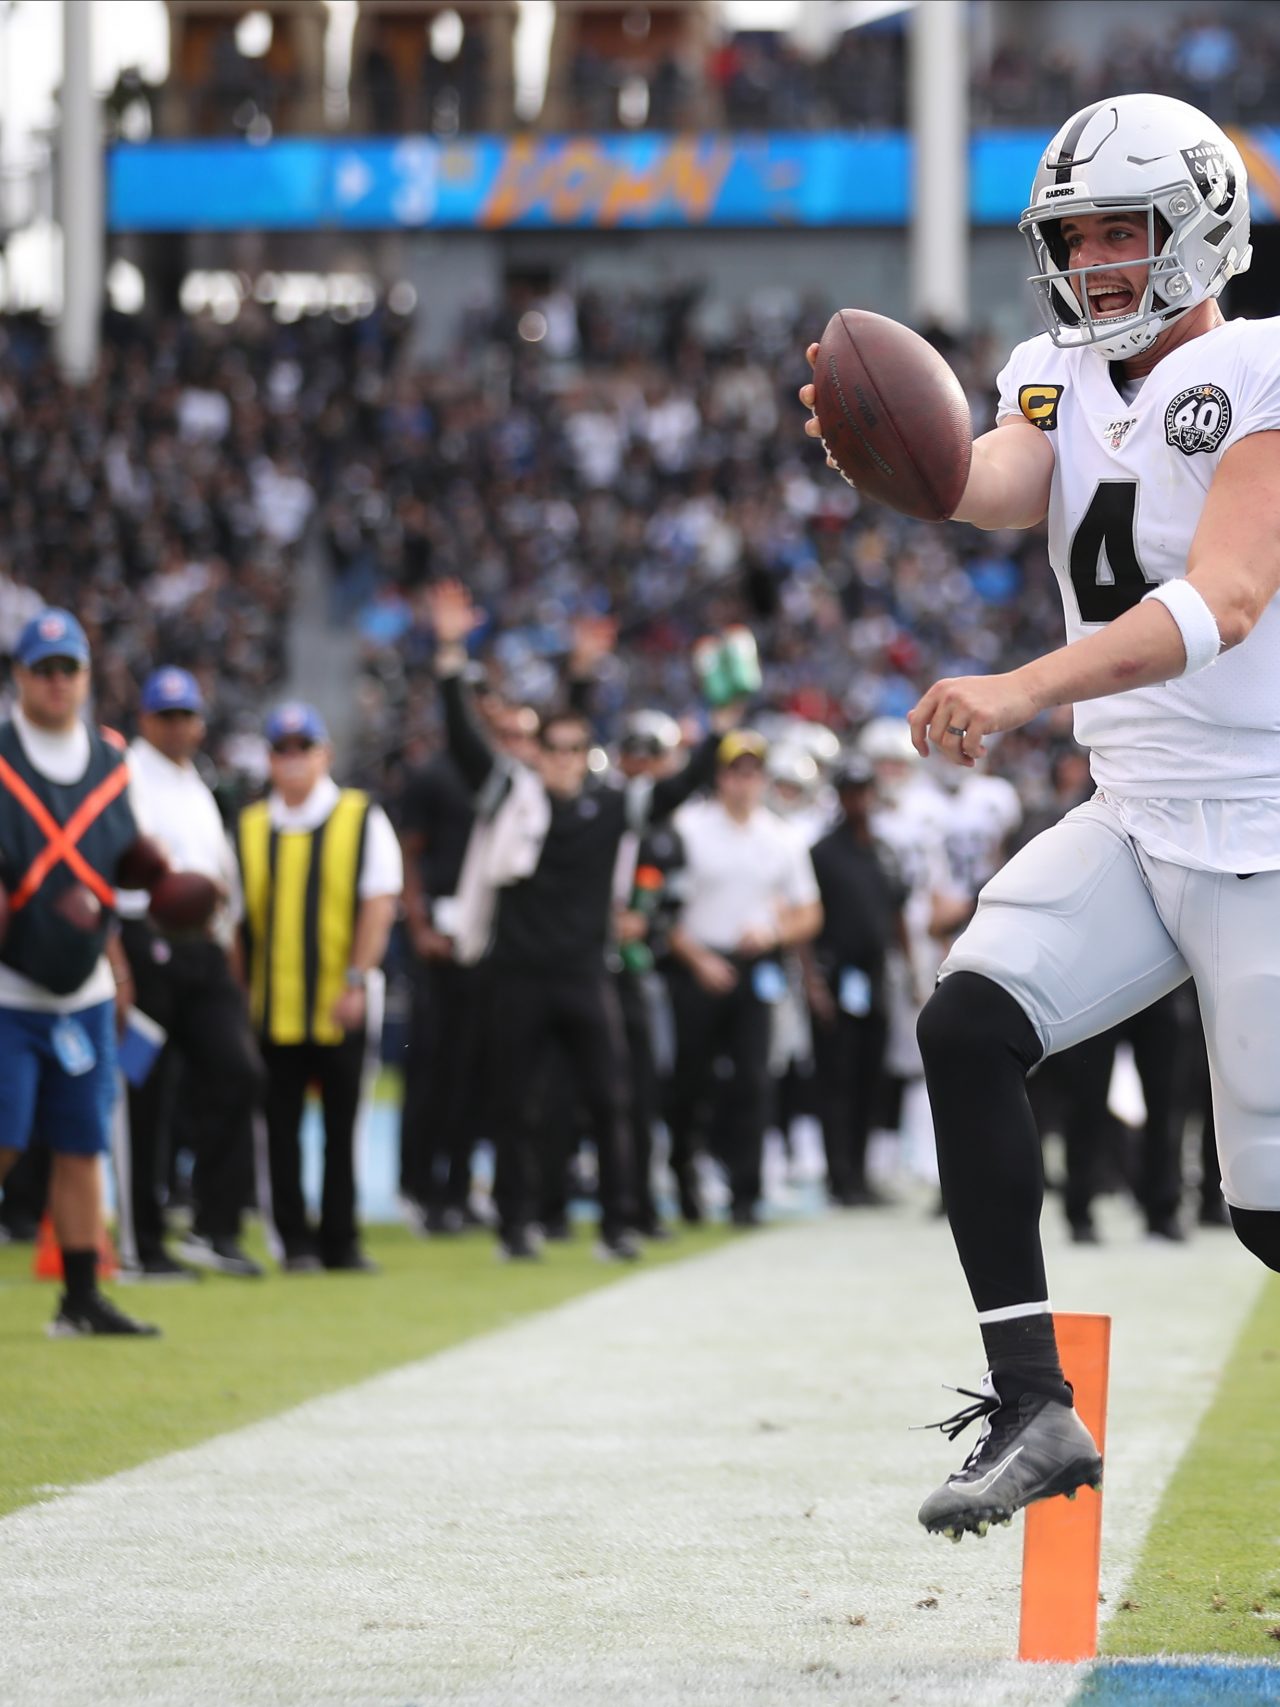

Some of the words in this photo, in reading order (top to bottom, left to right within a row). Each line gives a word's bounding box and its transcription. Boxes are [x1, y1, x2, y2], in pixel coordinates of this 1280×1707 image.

[1045, 188, 1075, 199] RAIDERS
[1020, 387, 1058, 420] C
[1174, 399, 1221, 434] 60
[1069, 480, 1163, 625] 4
